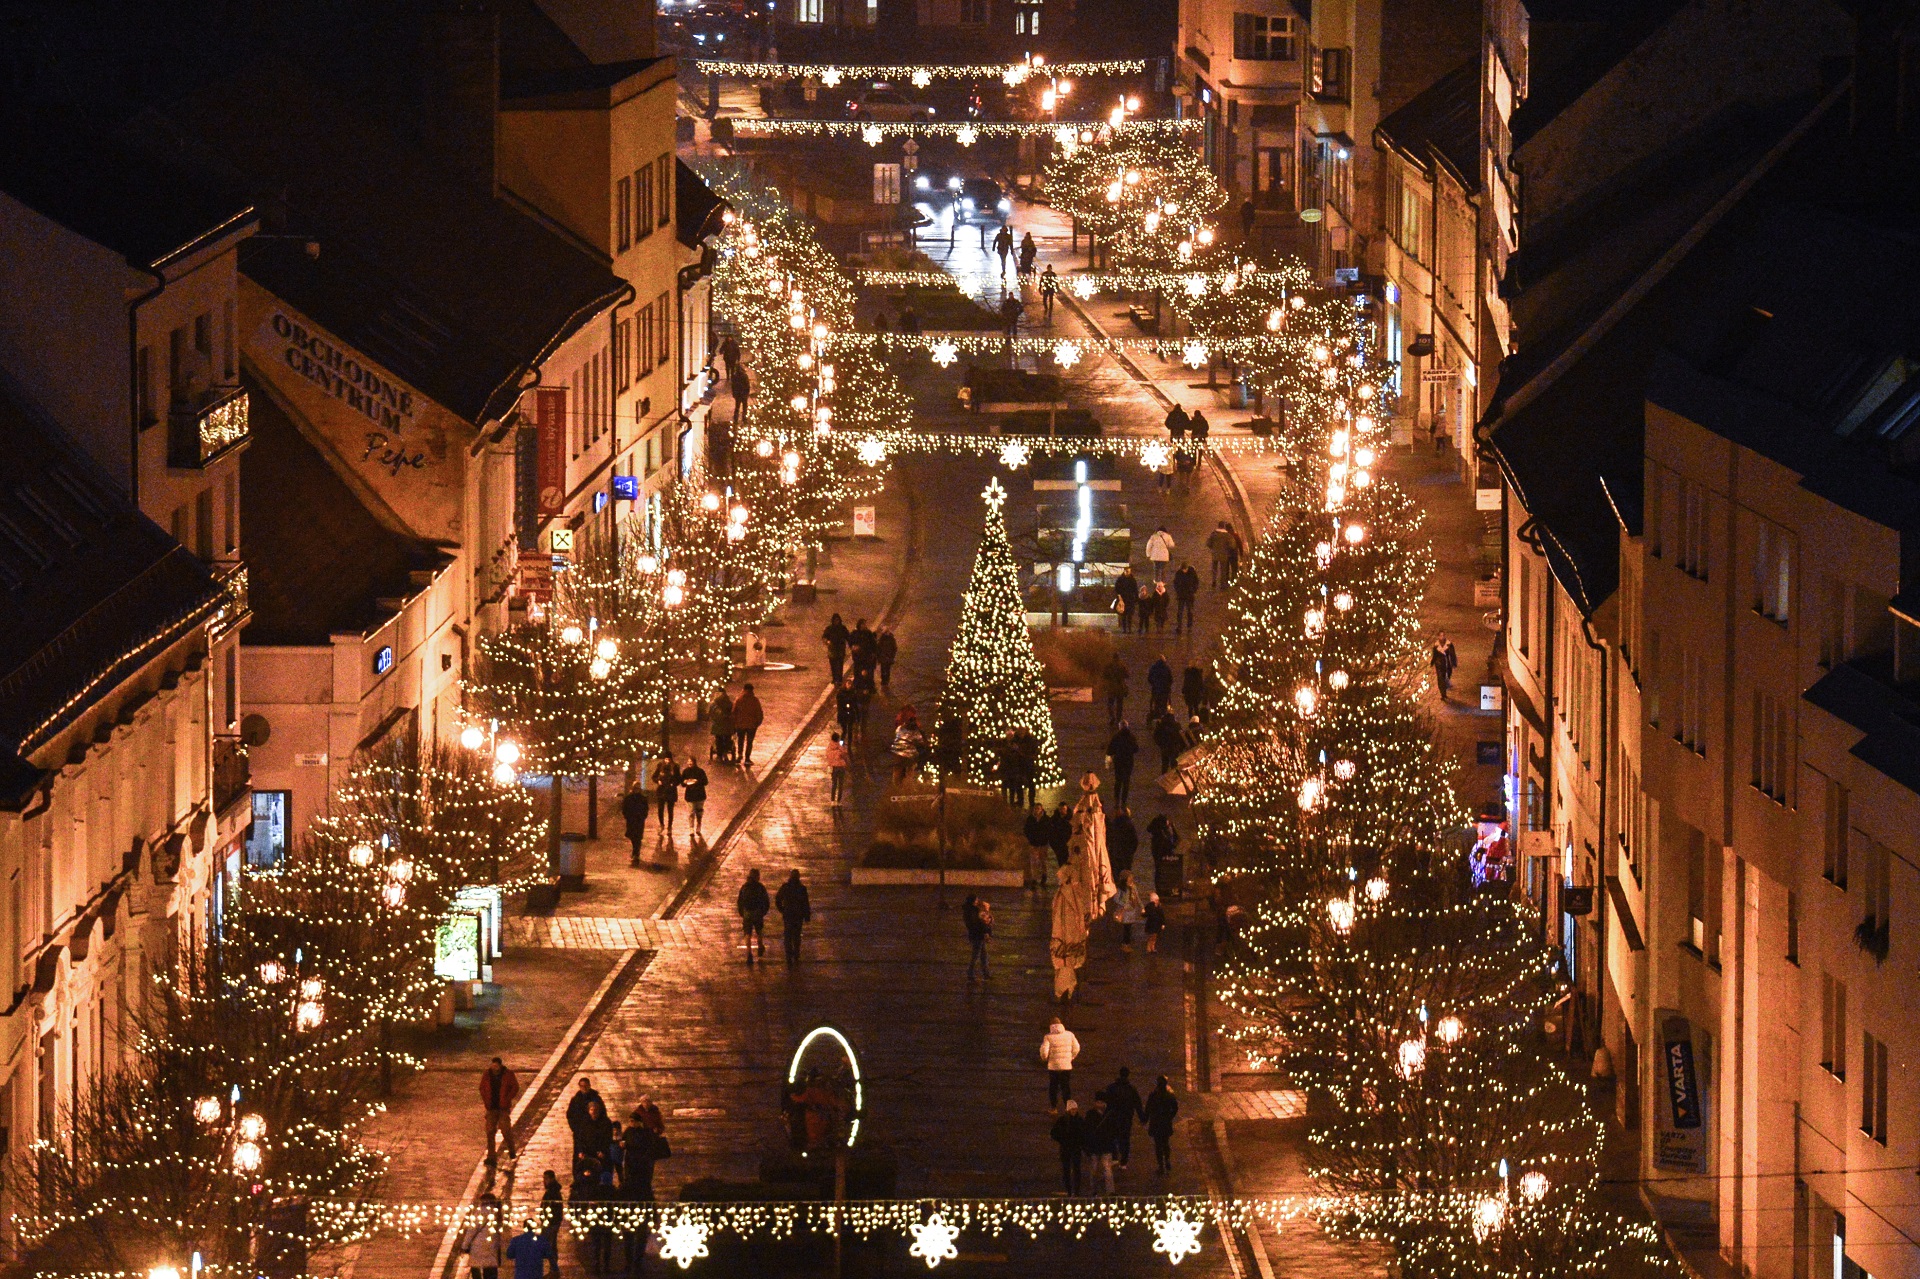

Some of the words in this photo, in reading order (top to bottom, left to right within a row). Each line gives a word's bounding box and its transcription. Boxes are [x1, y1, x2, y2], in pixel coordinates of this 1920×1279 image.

[271, 313, 413, 417] OBCHODNÉ
[285, 347, 400, 434] CENTRUM
[361, 432, 427, 477] Pepe
[1670, 1043, 1687, 1103] VARTA
